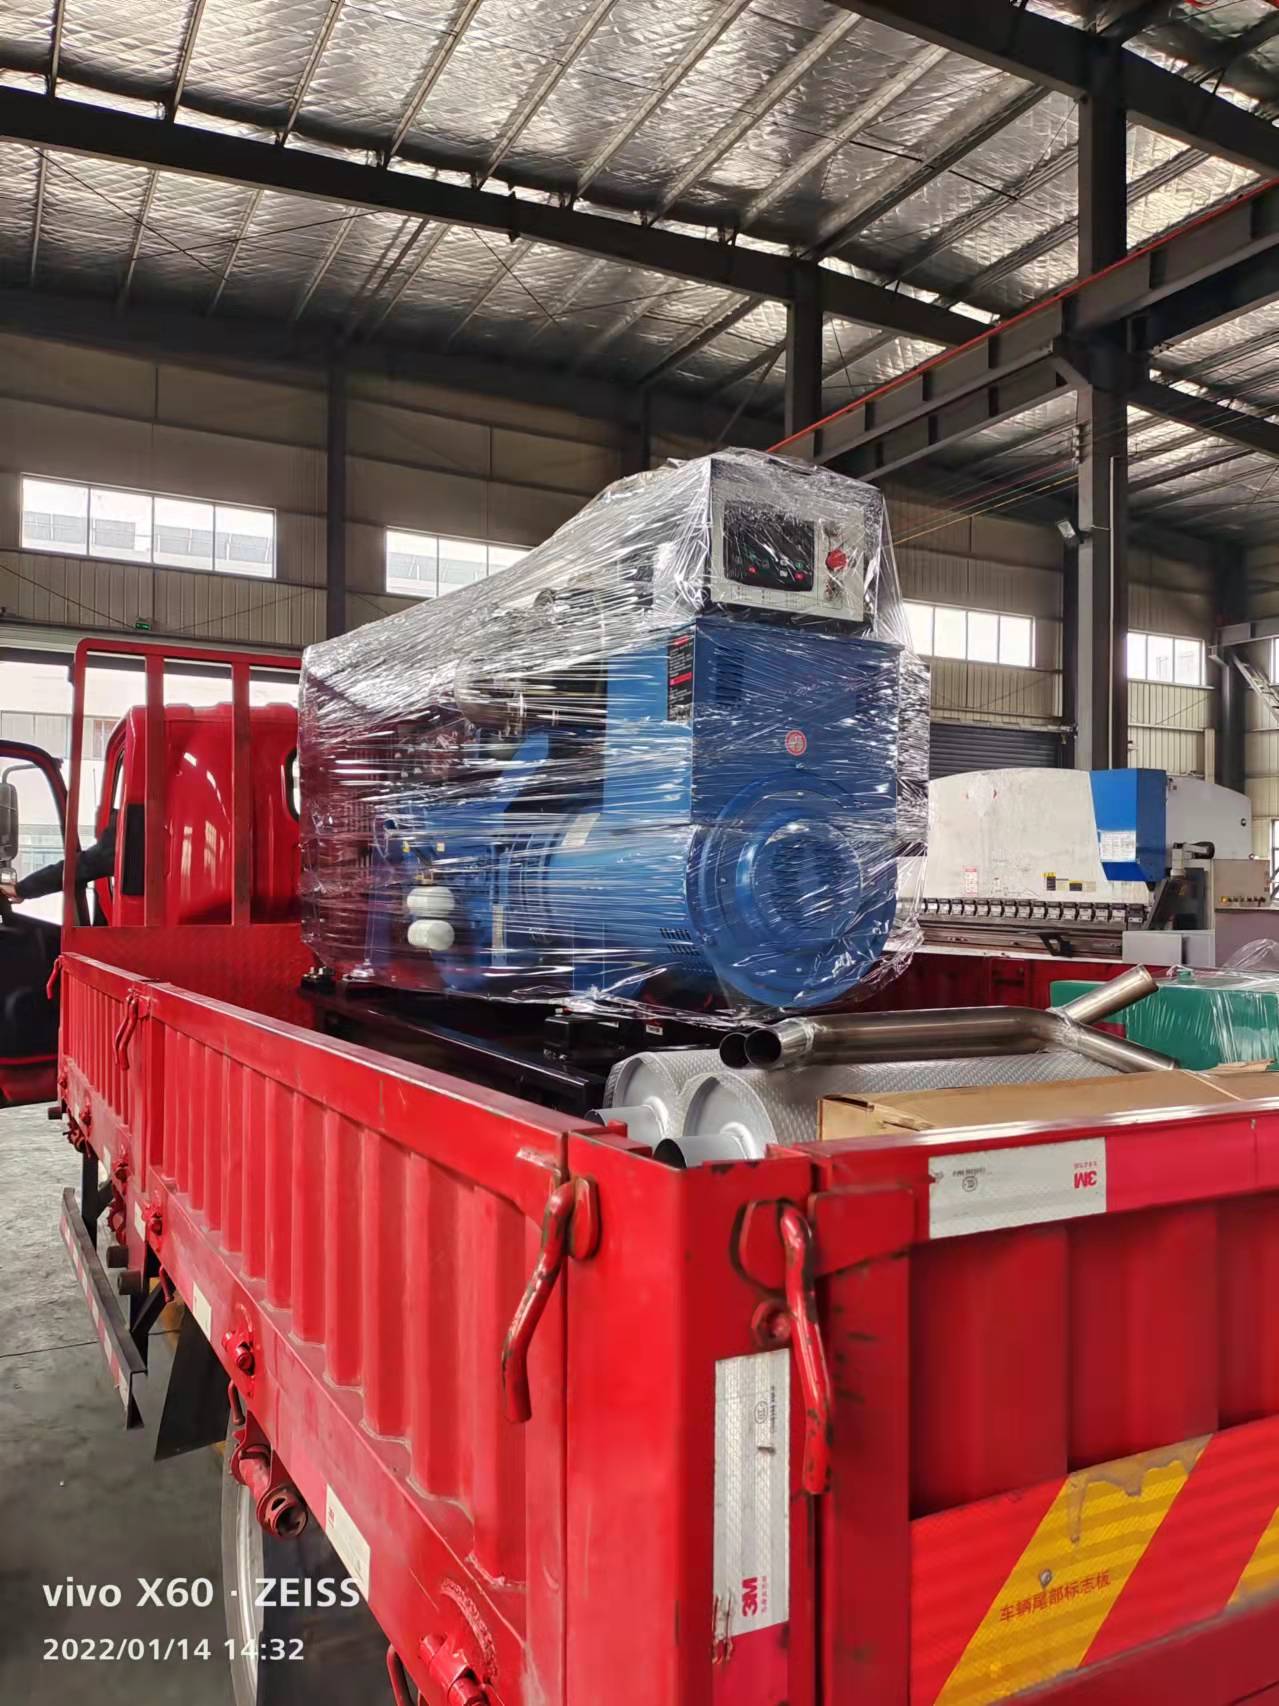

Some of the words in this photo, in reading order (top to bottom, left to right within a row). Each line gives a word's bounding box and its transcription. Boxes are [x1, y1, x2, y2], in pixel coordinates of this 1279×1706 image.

[1074, 1170, 1097, 1189] 3M
[741, 1577, 758, 1617] 3M
[999, 1568, 1112, 1622] 车辆尾部标志板
